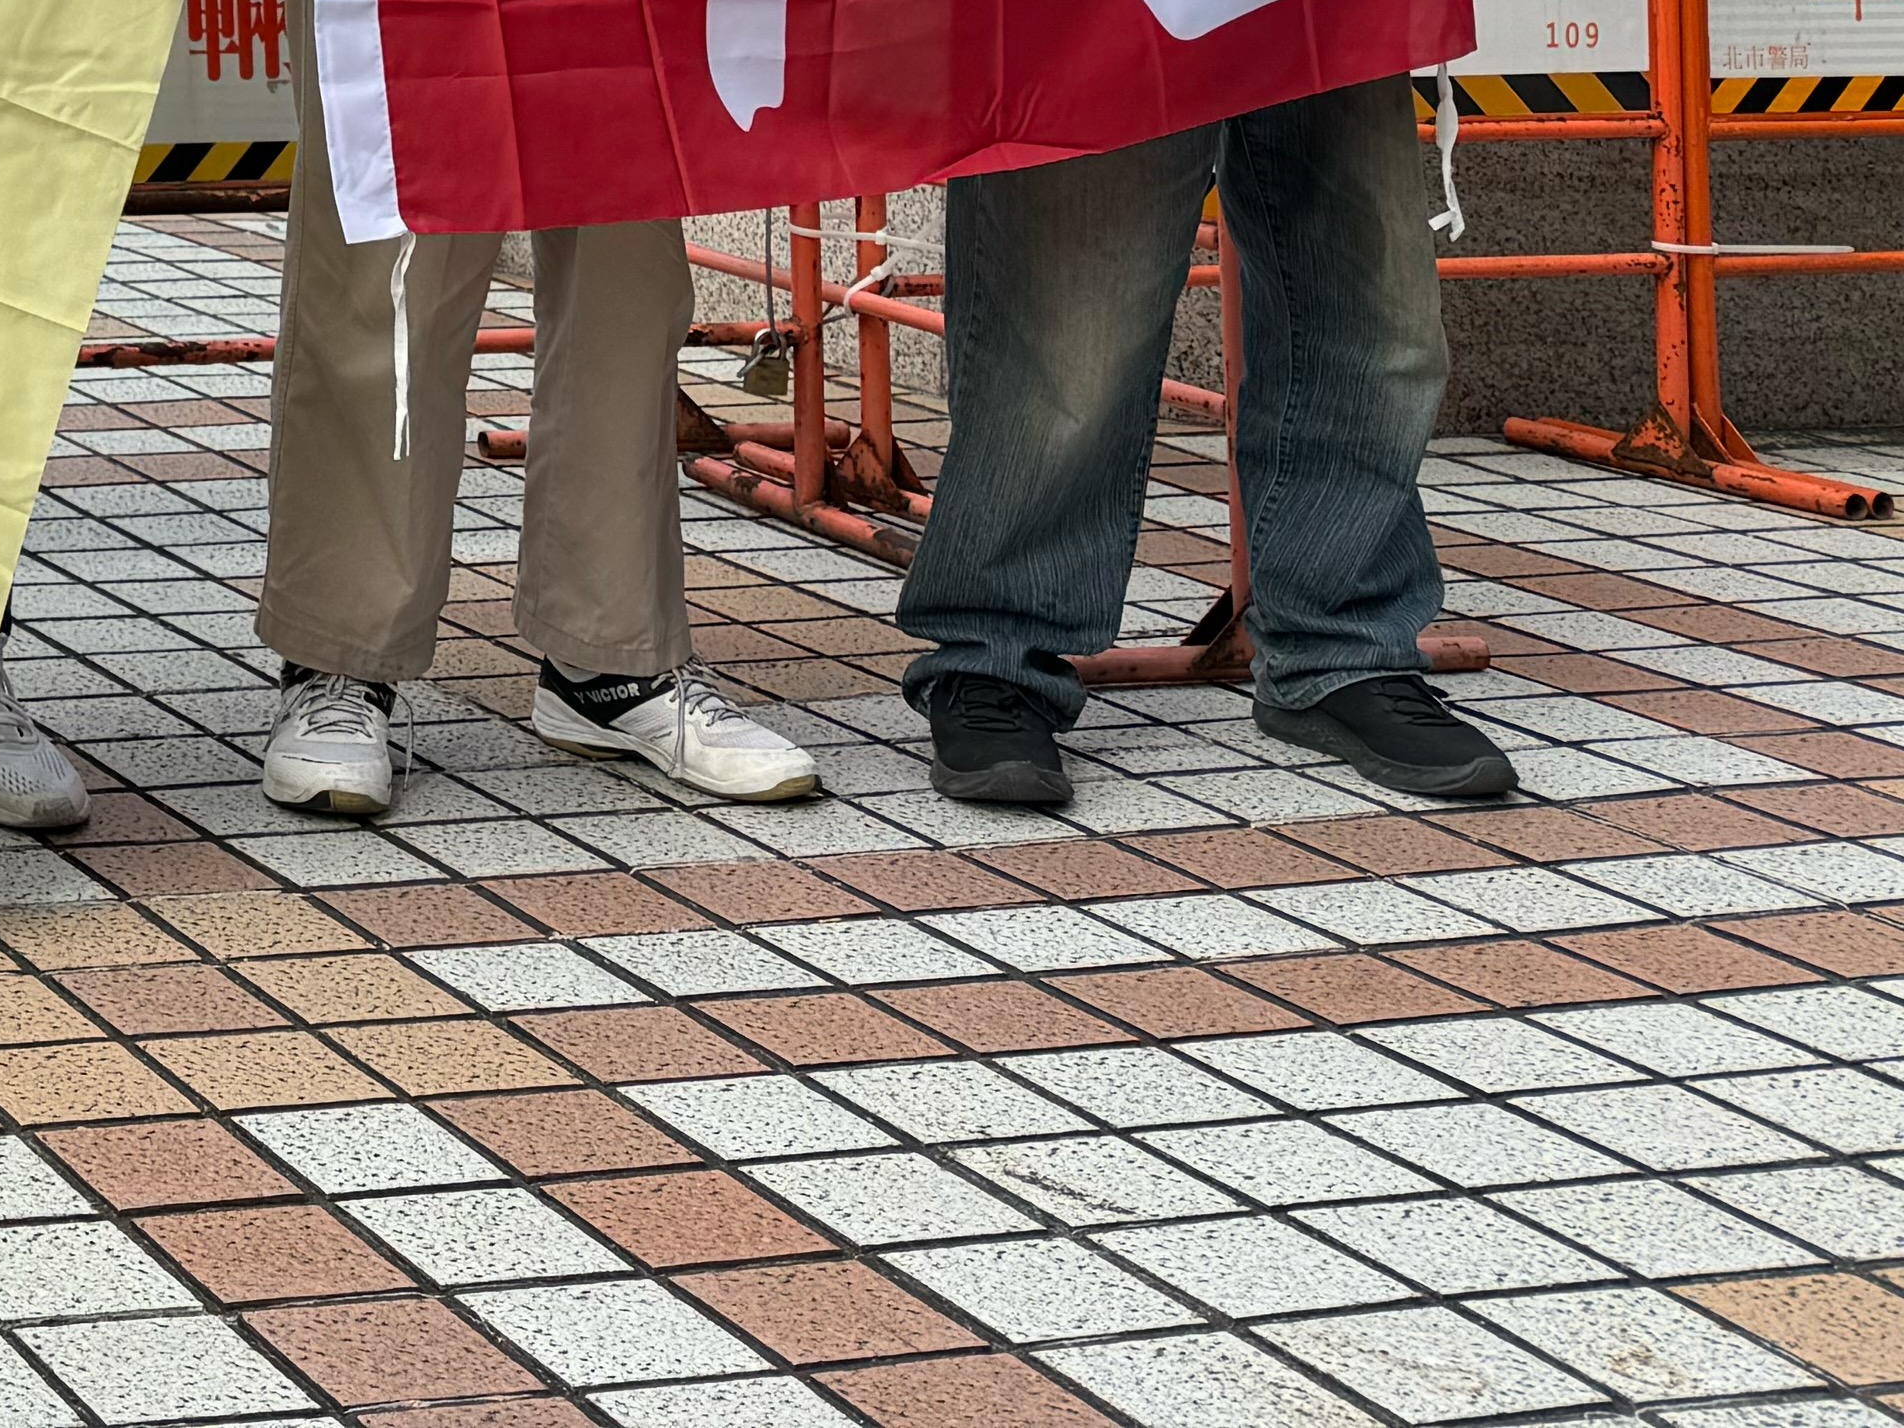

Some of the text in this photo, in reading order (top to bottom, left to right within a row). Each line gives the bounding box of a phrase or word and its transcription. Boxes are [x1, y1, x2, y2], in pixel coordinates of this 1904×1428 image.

[1545, 21, 1600, 49] 109
[1722, 45, 1811, 71] 北市警局
